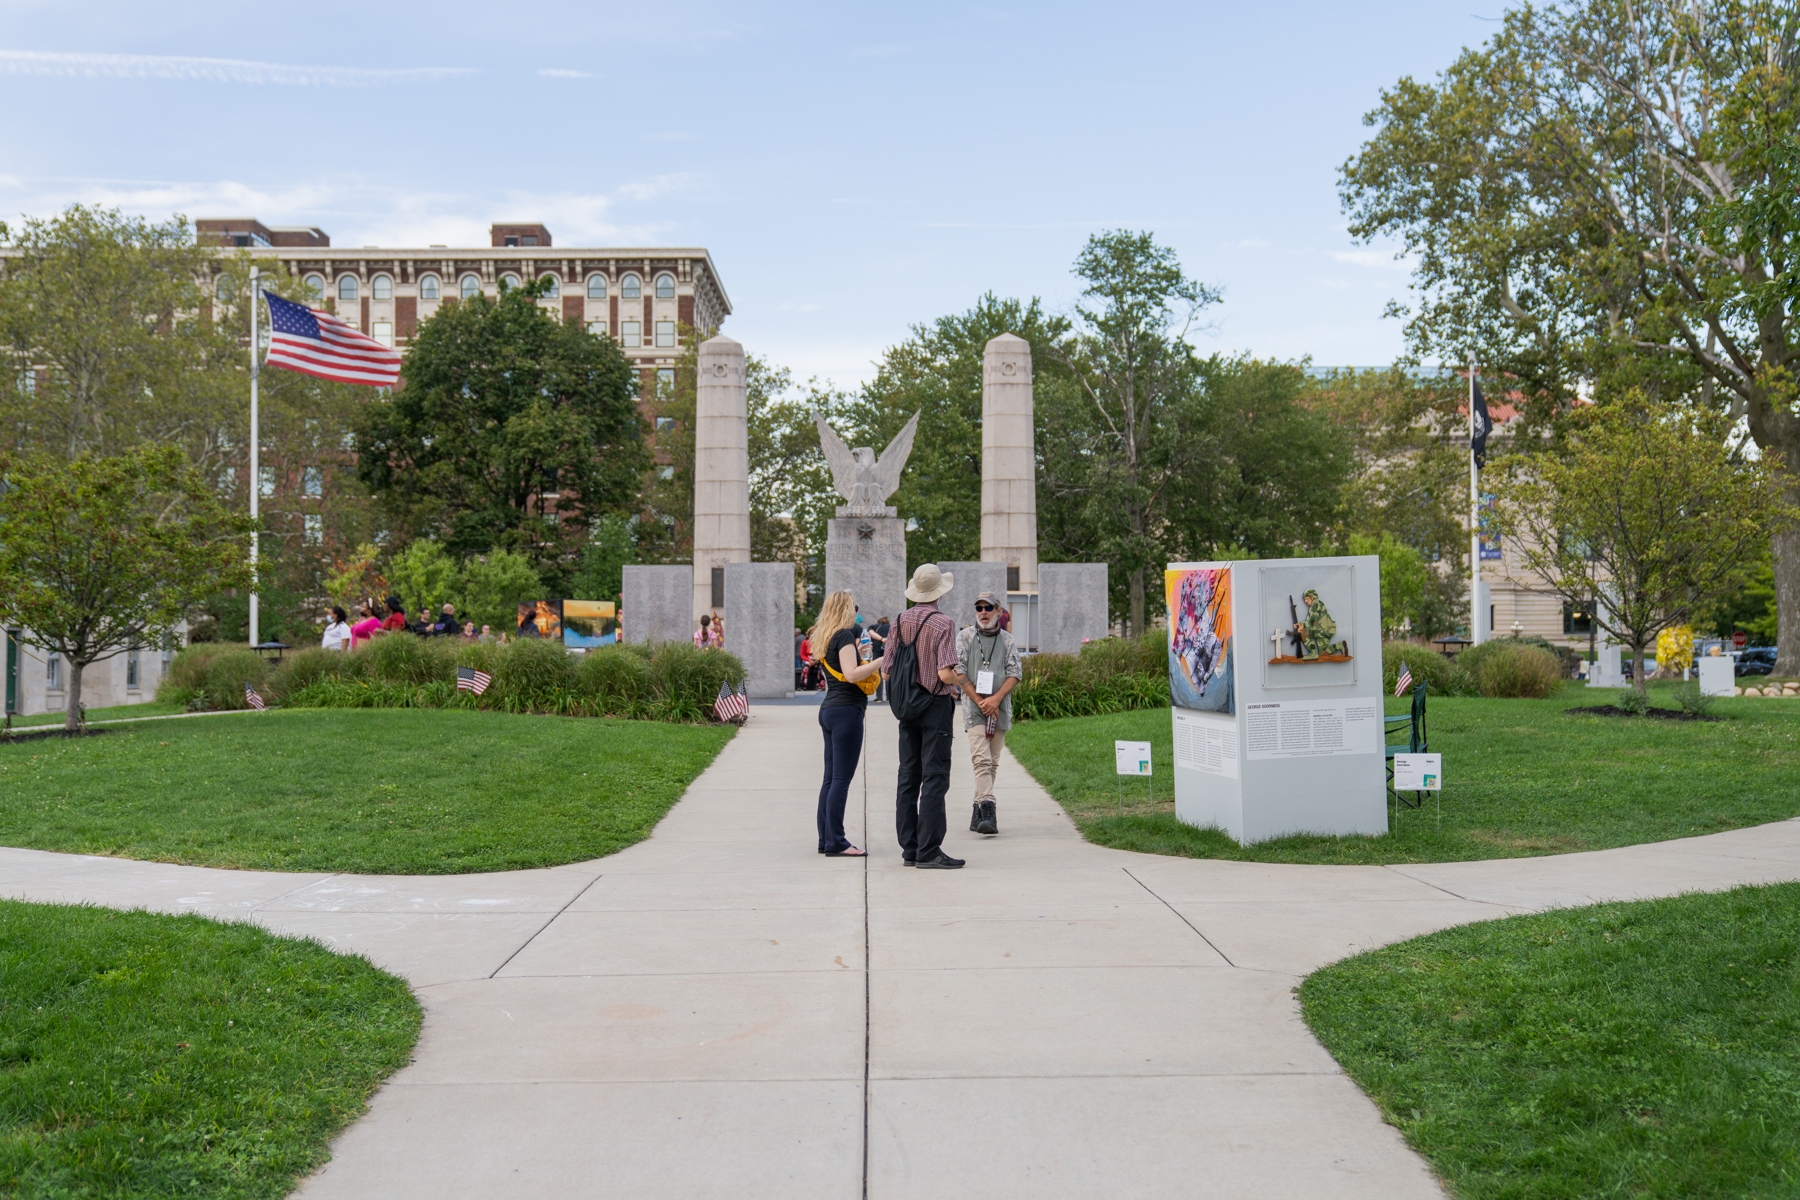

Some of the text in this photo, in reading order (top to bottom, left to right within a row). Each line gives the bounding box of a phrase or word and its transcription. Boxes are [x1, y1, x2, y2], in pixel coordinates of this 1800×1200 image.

[829, 543, 904, 553] THEY PERISHED
[828, 552, 904, 562] DEFENDING US
[1733, 635, 1746, 643] STOP
